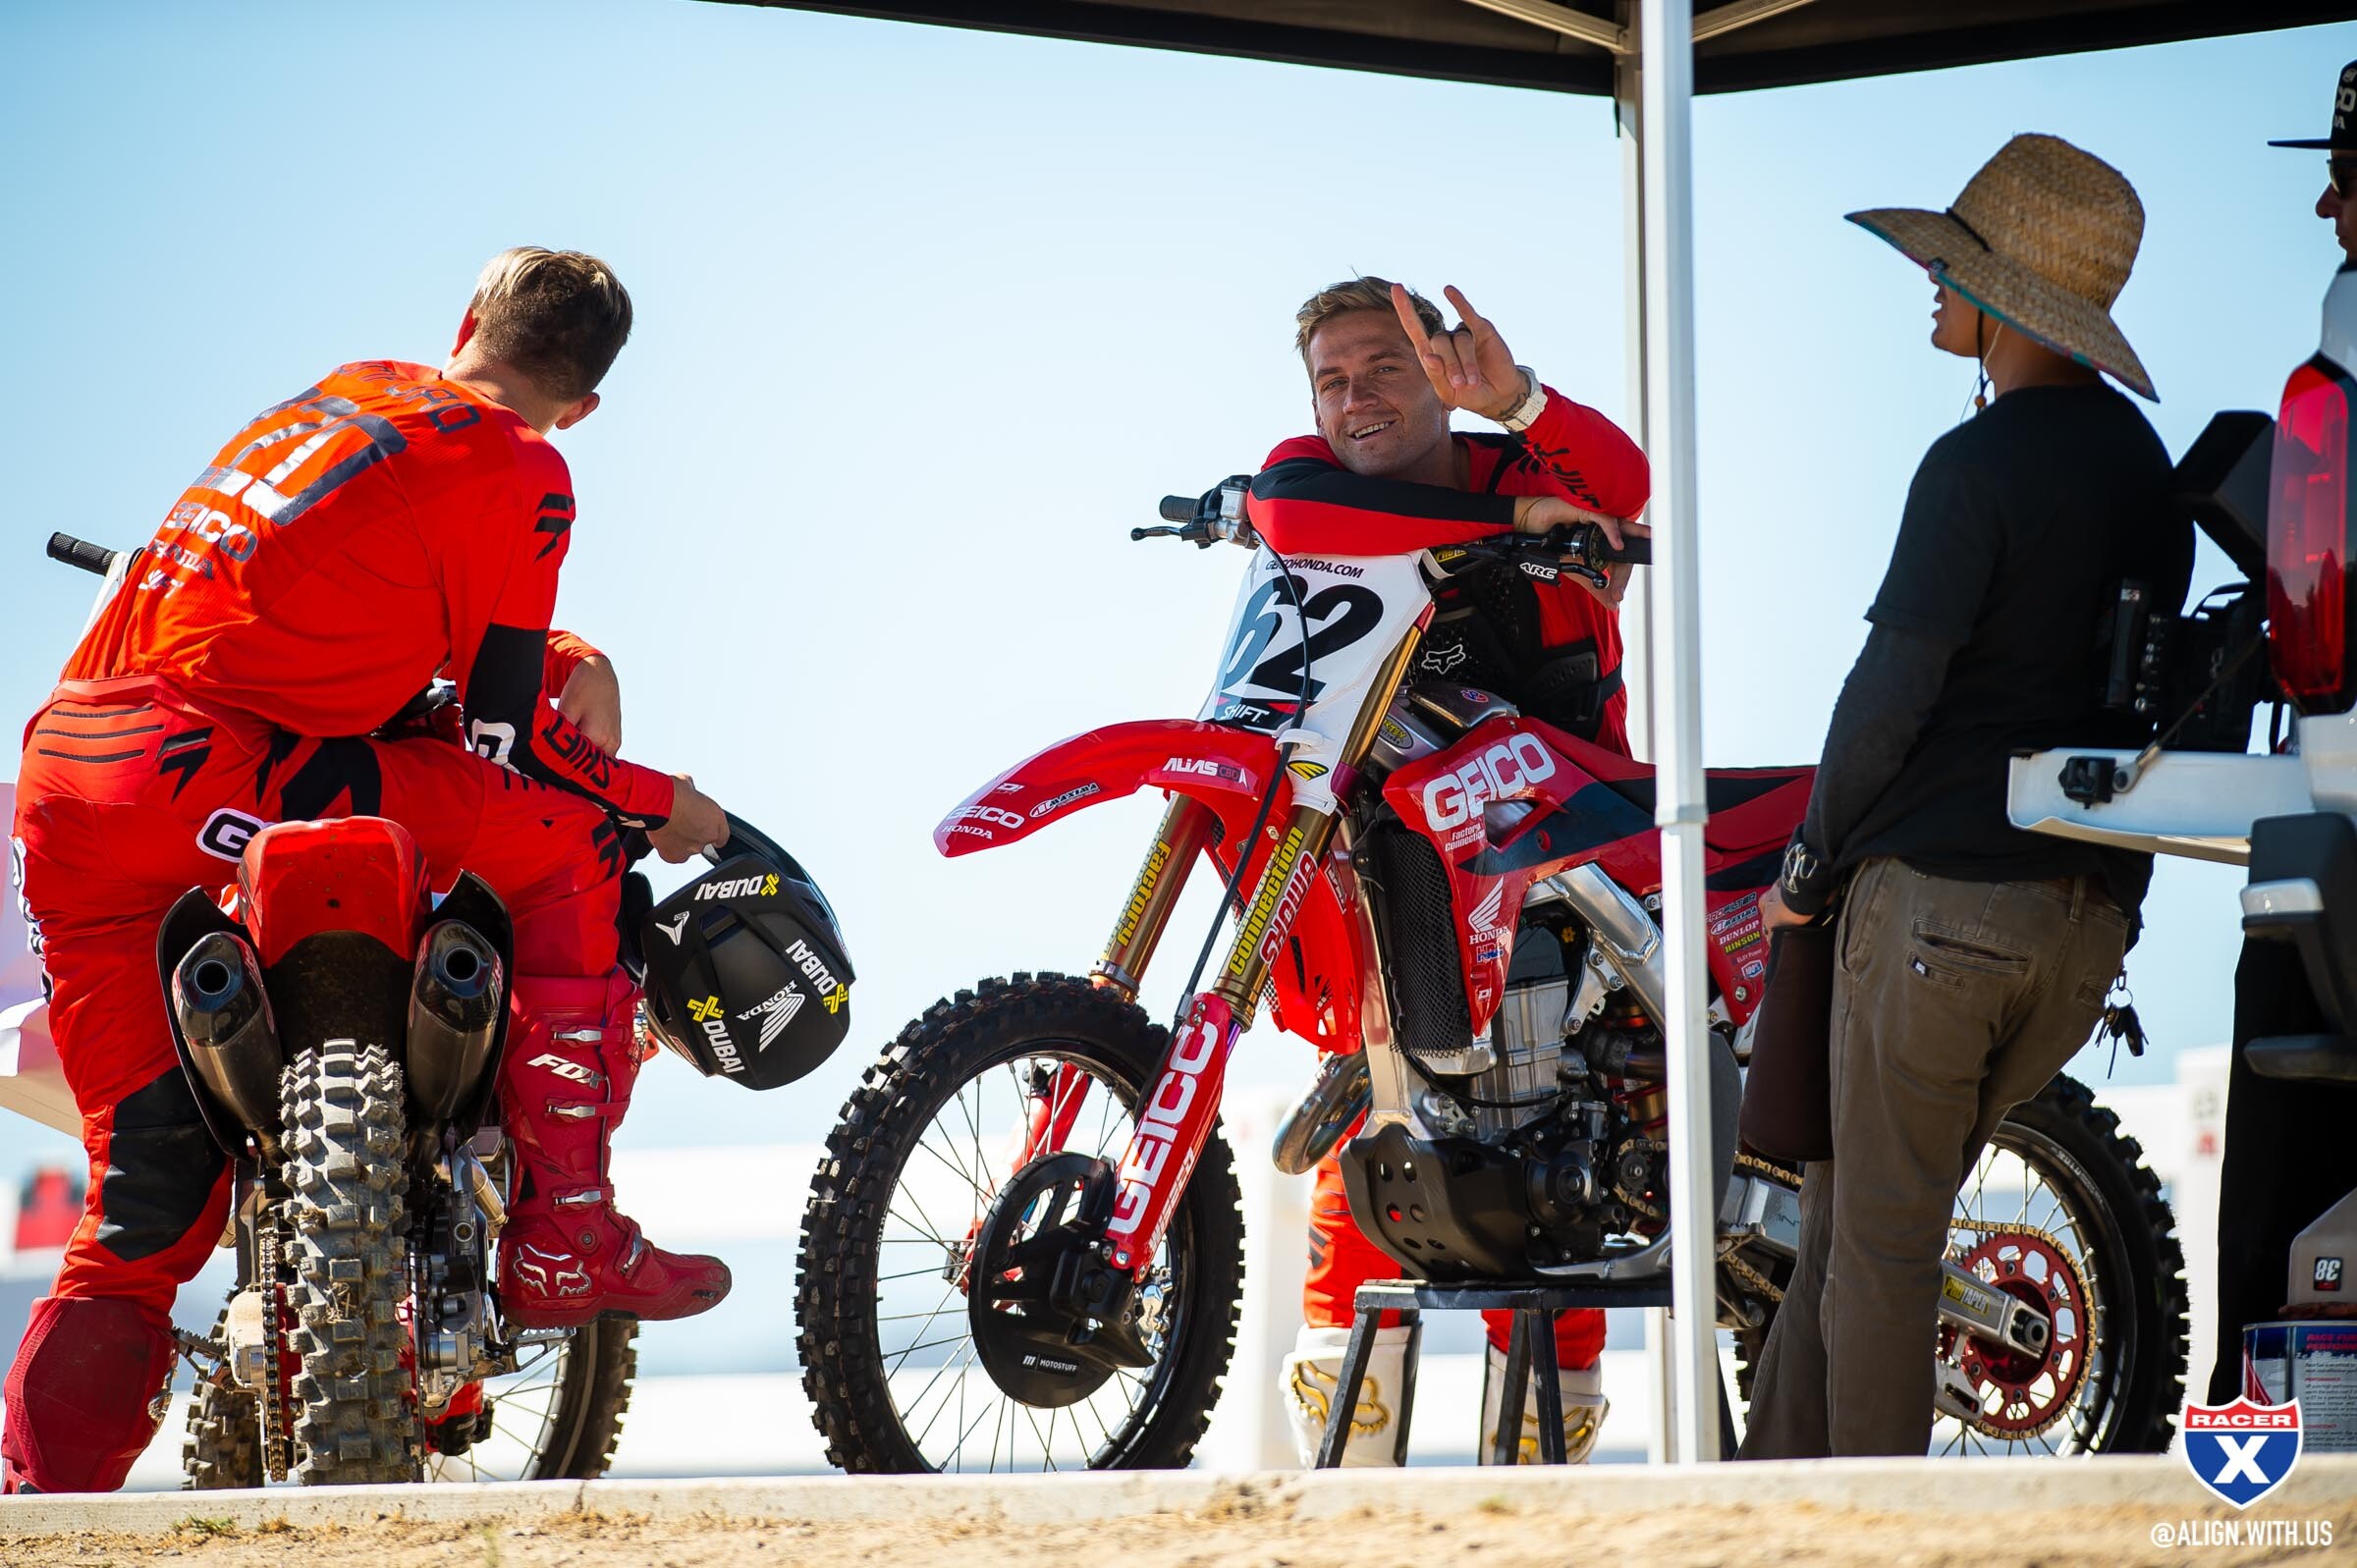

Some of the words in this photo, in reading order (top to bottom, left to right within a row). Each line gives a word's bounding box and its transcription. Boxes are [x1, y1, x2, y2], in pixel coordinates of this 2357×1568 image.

[1519, 562, 1559, 580] ARC
[1220, 573, 1385, 702] 62
[1224, 704, 1271, 723] SHIFT
[1423, 731, 1557, 833] GEICO
[1048, 783, 1099, 807] MAXIMA
[945, 805, 1025, 830] GEICO
[942, 824, 994, 840] HONDA
[1259, 850, 1318, 971] SHOWA
[1469, 925, 1511, 945] HONDA
[1719, 919, 1760, 946] DUNLOP
[1725, 930, 1761, 954] HINSON
[736, 978, 798, 1020] HONDA
[527, 1053, 601, 1089] FOX
[1108, 1020, 1218, 1234] GEICO
[1040, 1359, 1077, 1373] MOTOSTUFF
